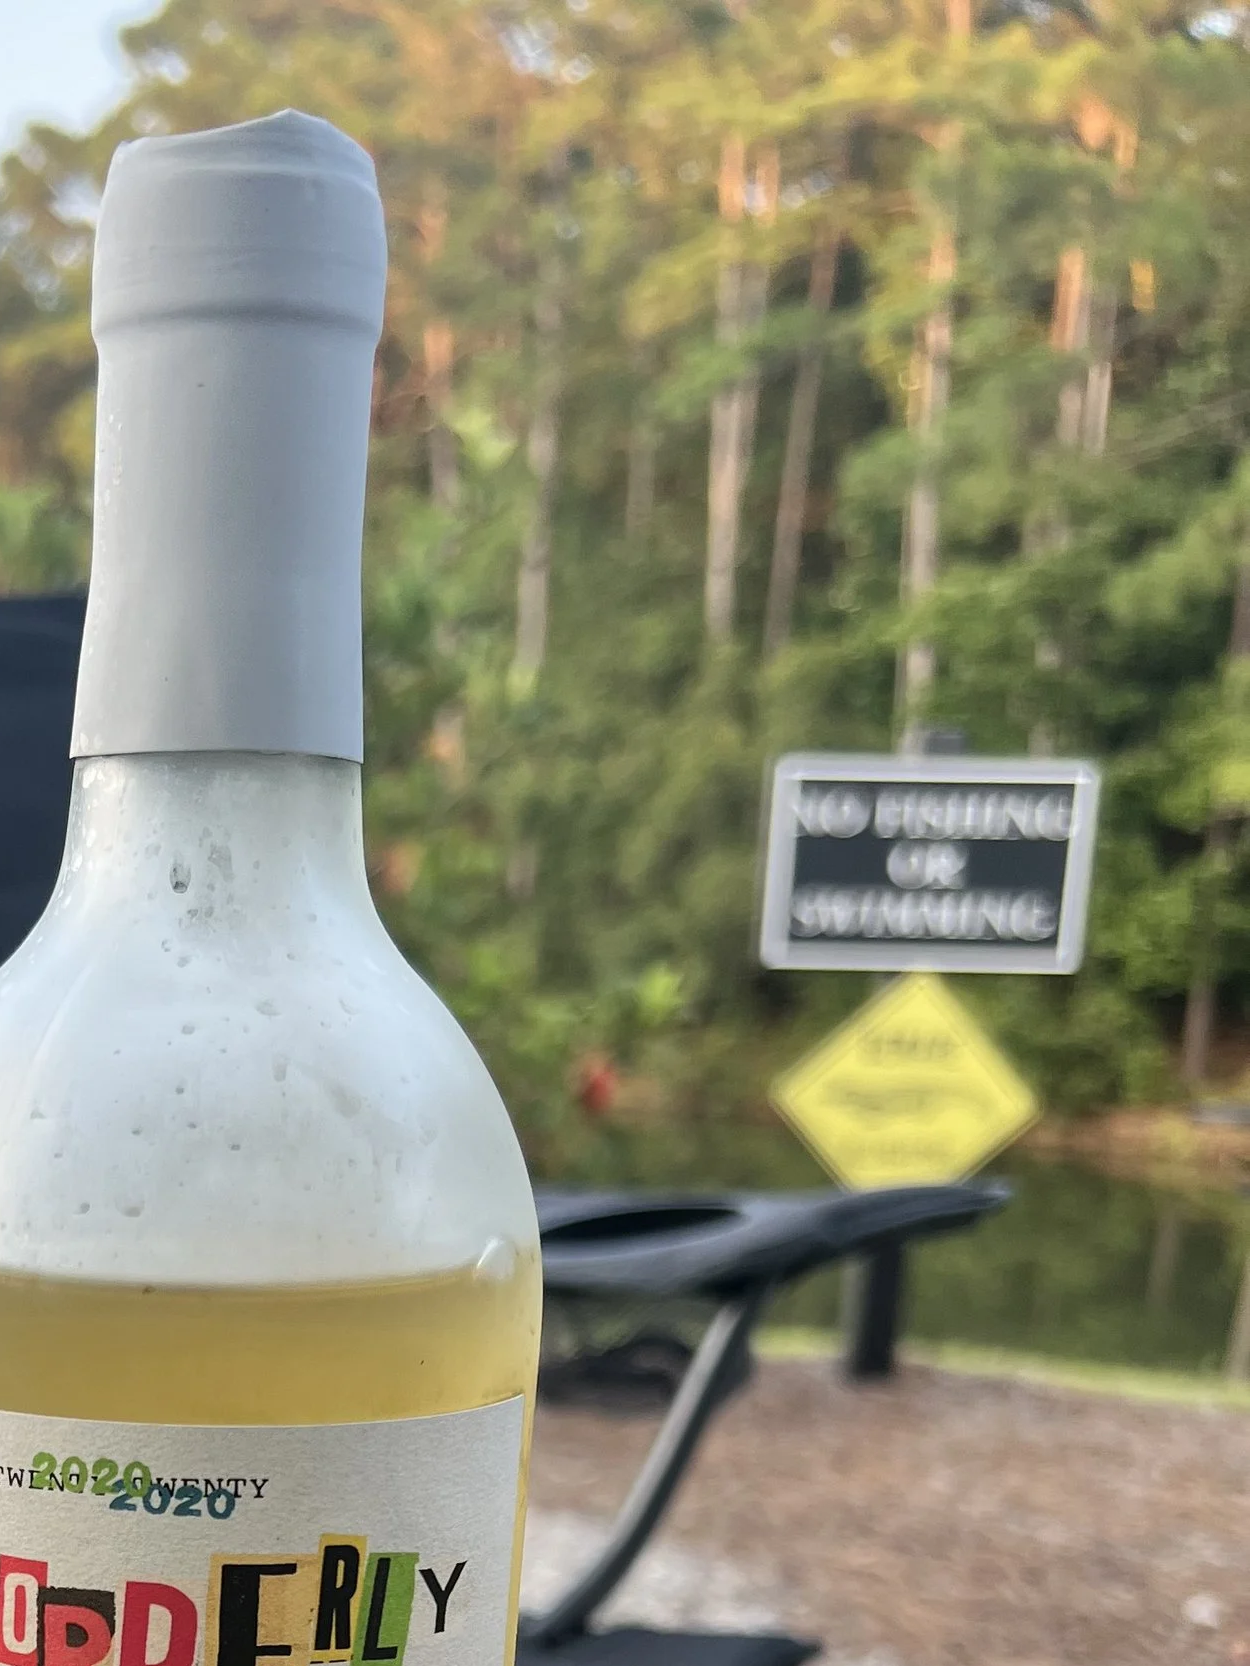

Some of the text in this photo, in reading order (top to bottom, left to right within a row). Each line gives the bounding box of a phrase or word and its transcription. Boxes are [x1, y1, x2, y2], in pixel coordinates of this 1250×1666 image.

[792, 785, 872, 838] NO
[886, 840, 968, 889] OR
[32, 1451, 152, 1498] 2020
[109, 1479, 236, 1520] 2020
